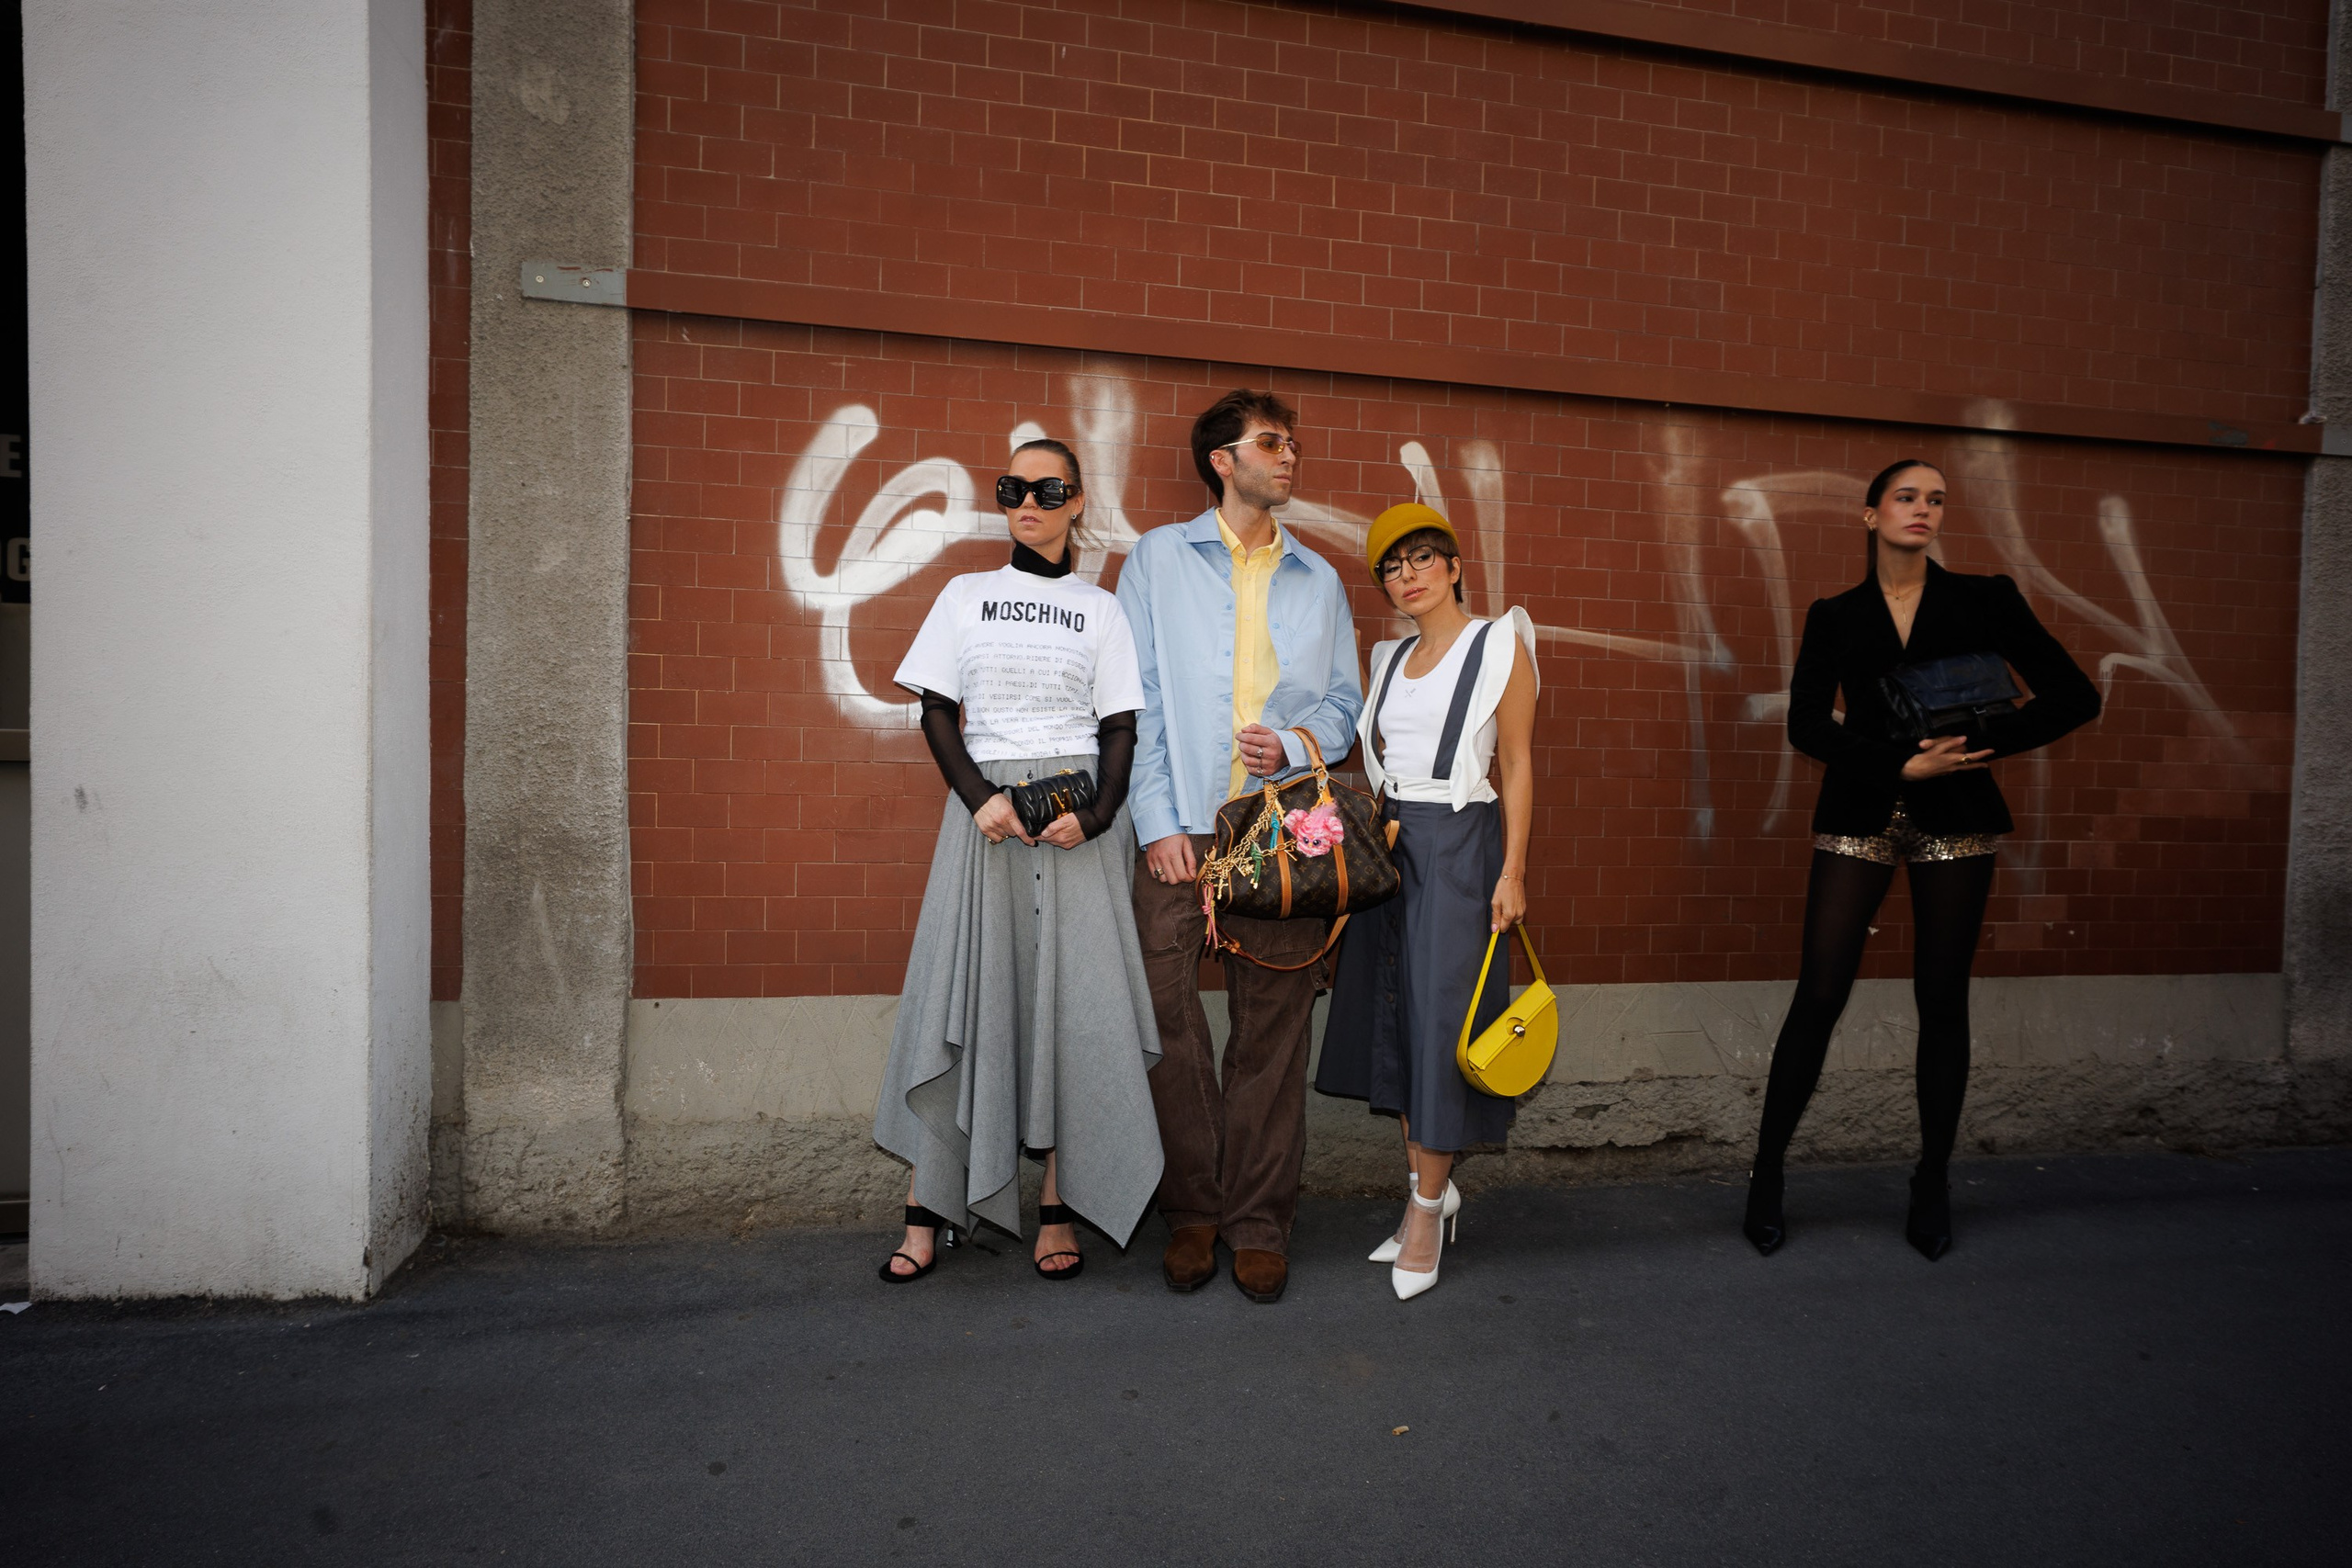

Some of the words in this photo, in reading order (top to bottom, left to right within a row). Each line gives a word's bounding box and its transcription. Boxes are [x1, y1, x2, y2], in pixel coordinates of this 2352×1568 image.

[981, 601, 1085, 633] MOSCHINO
[1001, 667, 1026, 675] QUELLI
[1030, 668, 1035, 676] A
[1042, 682, 1061, 691] TUTTI
[989, 693, 1022, 701] VESTIRSI
[1025, 694, 1041, 703] COME
[1032, 705, 1057, 714] ESISTE
